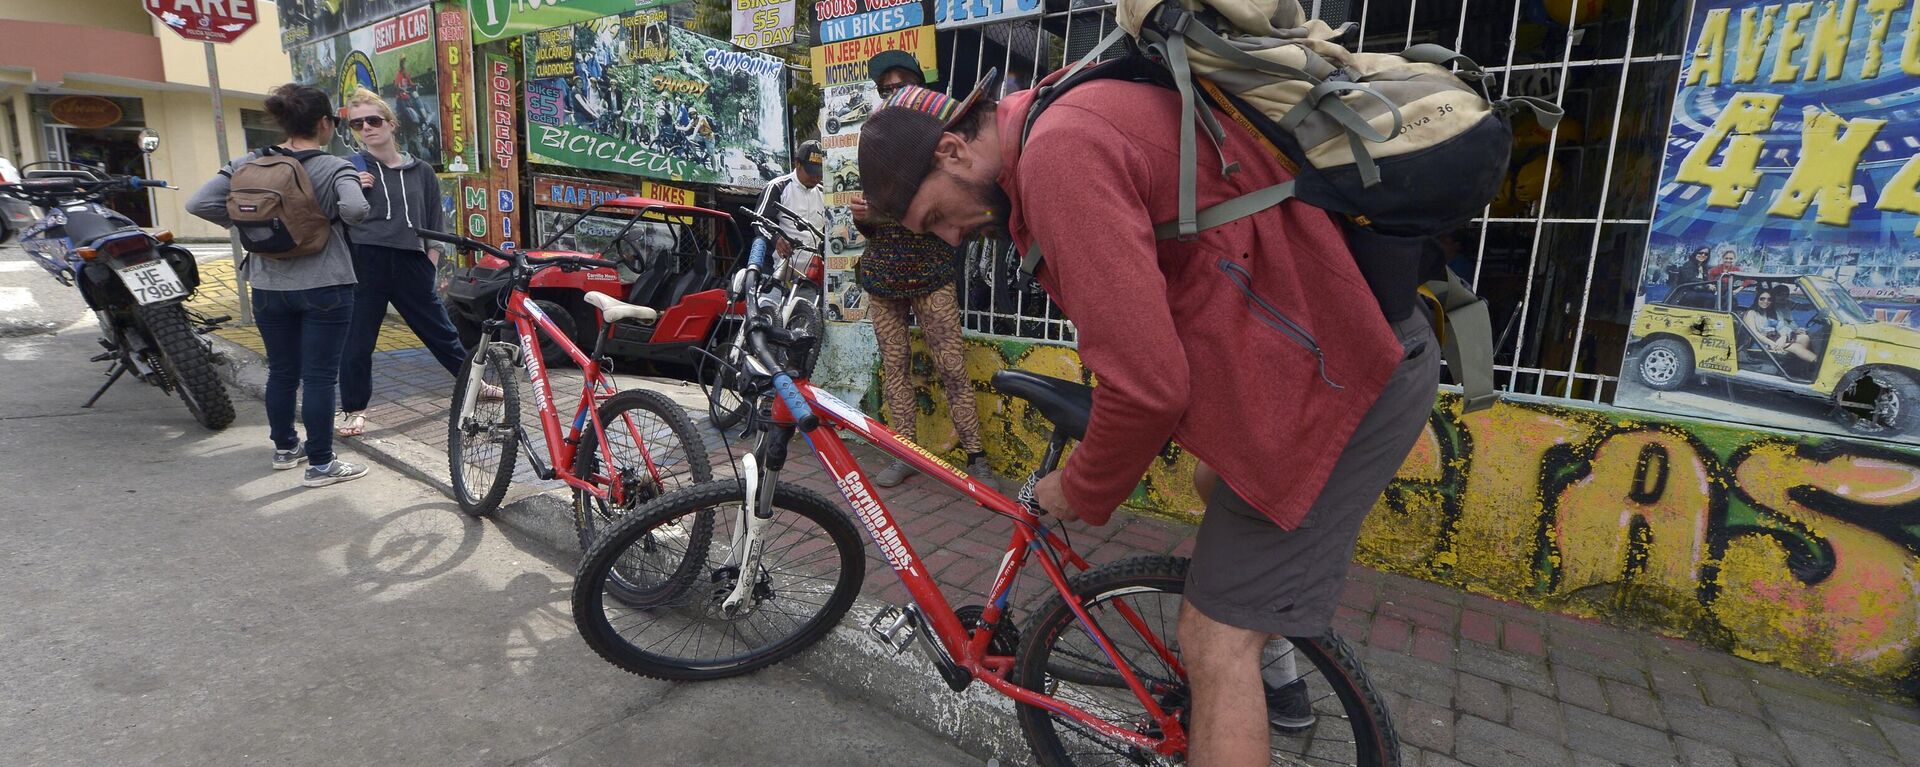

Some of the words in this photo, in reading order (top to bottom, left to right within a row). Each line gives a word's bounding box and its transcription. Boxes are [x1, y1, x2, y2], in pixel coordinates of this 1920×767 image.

[440, 11, 464, 27] FOR
[752, 8, 780, 32] $5
[815, 0, 857, 21] TOURS
[375, 22, 397, 49] RENT
[399, 23, 406, 42] A
[407, 13, 428, 40] CAR
[438, 26, 465, 42] RENT
[733, 33, 758, 48] TO
[761, 25, 795, 46] DAY
[824, 44, 835, 65] IN
[837, 40, 861, 63] JEEP
[900, 28, 919, 51] ATV
[536, 62, 574, 78] CUADRONES
[704, 48, 785, 79] CANYONING
[825, 58, 869, 85] MOTORCIC
[493, 60, 511, 107] FOR
[527, 82, 560, 99] bikes
[652, 74, 709, 100] CANOPY
[447, 46, 464, 153] BIKES
[1436, 103, 1454, 117] 36
[528, 110, 560, 127] today
[494, 109, 514, 169] RENT
[822, 132, 860, 150] BUGGY
[539, 126, 689, 177] BICICLETAS
[650, 183, 685, 206] BIKES
[134, 268, 165, 286] HE
[133, 280, 186, 302] 798U
[844, 470, 888, 530] Carrillo
